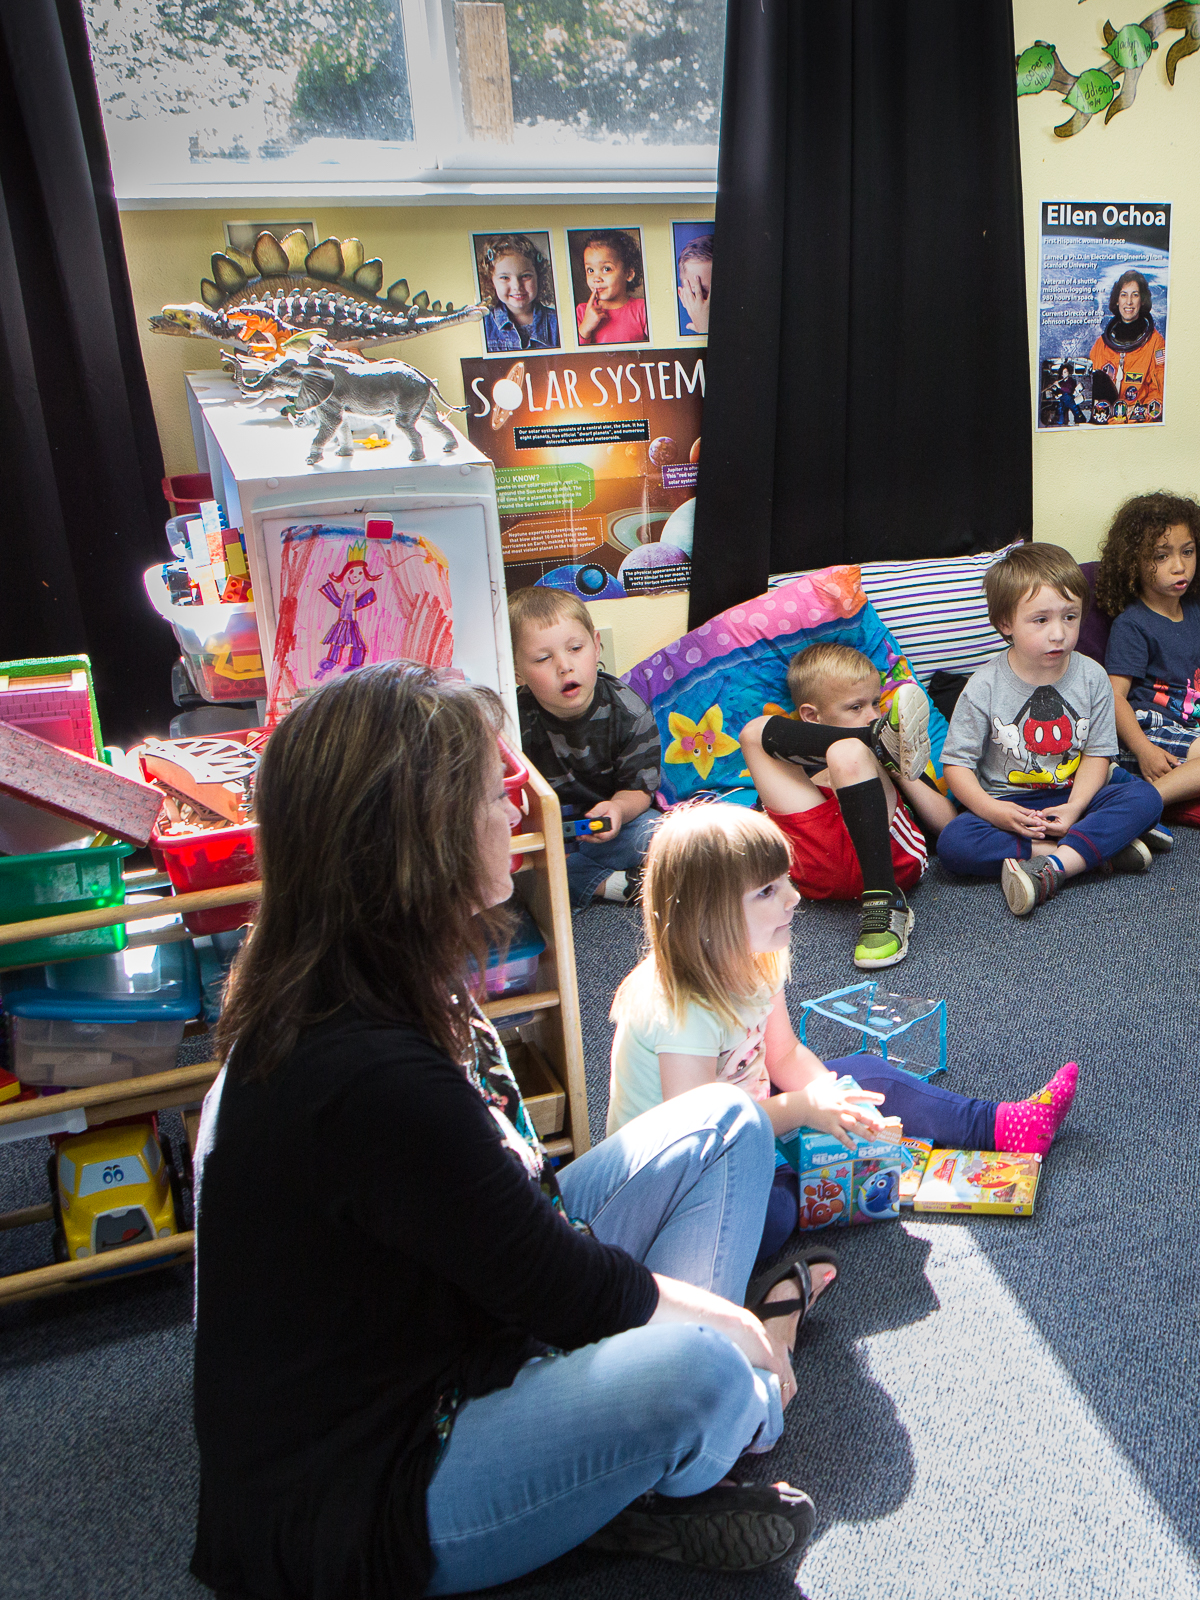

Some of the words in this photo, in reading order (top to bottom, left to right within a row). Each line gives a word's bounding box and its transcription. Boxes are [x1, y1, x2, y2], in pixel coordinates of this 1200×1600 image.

[1022, 55, 1044, 88] Cooper
[1076, 81, 1114, 104] Addison
[1047, 205, 1097, 225] Ellen
[1102, 205, 1166, 226] Ochoa
[590, 358, 706, 408] SYSTEM
[812, 1153, 848, 1165] NEMO
[858, 1146, 892, 1158] DORY
